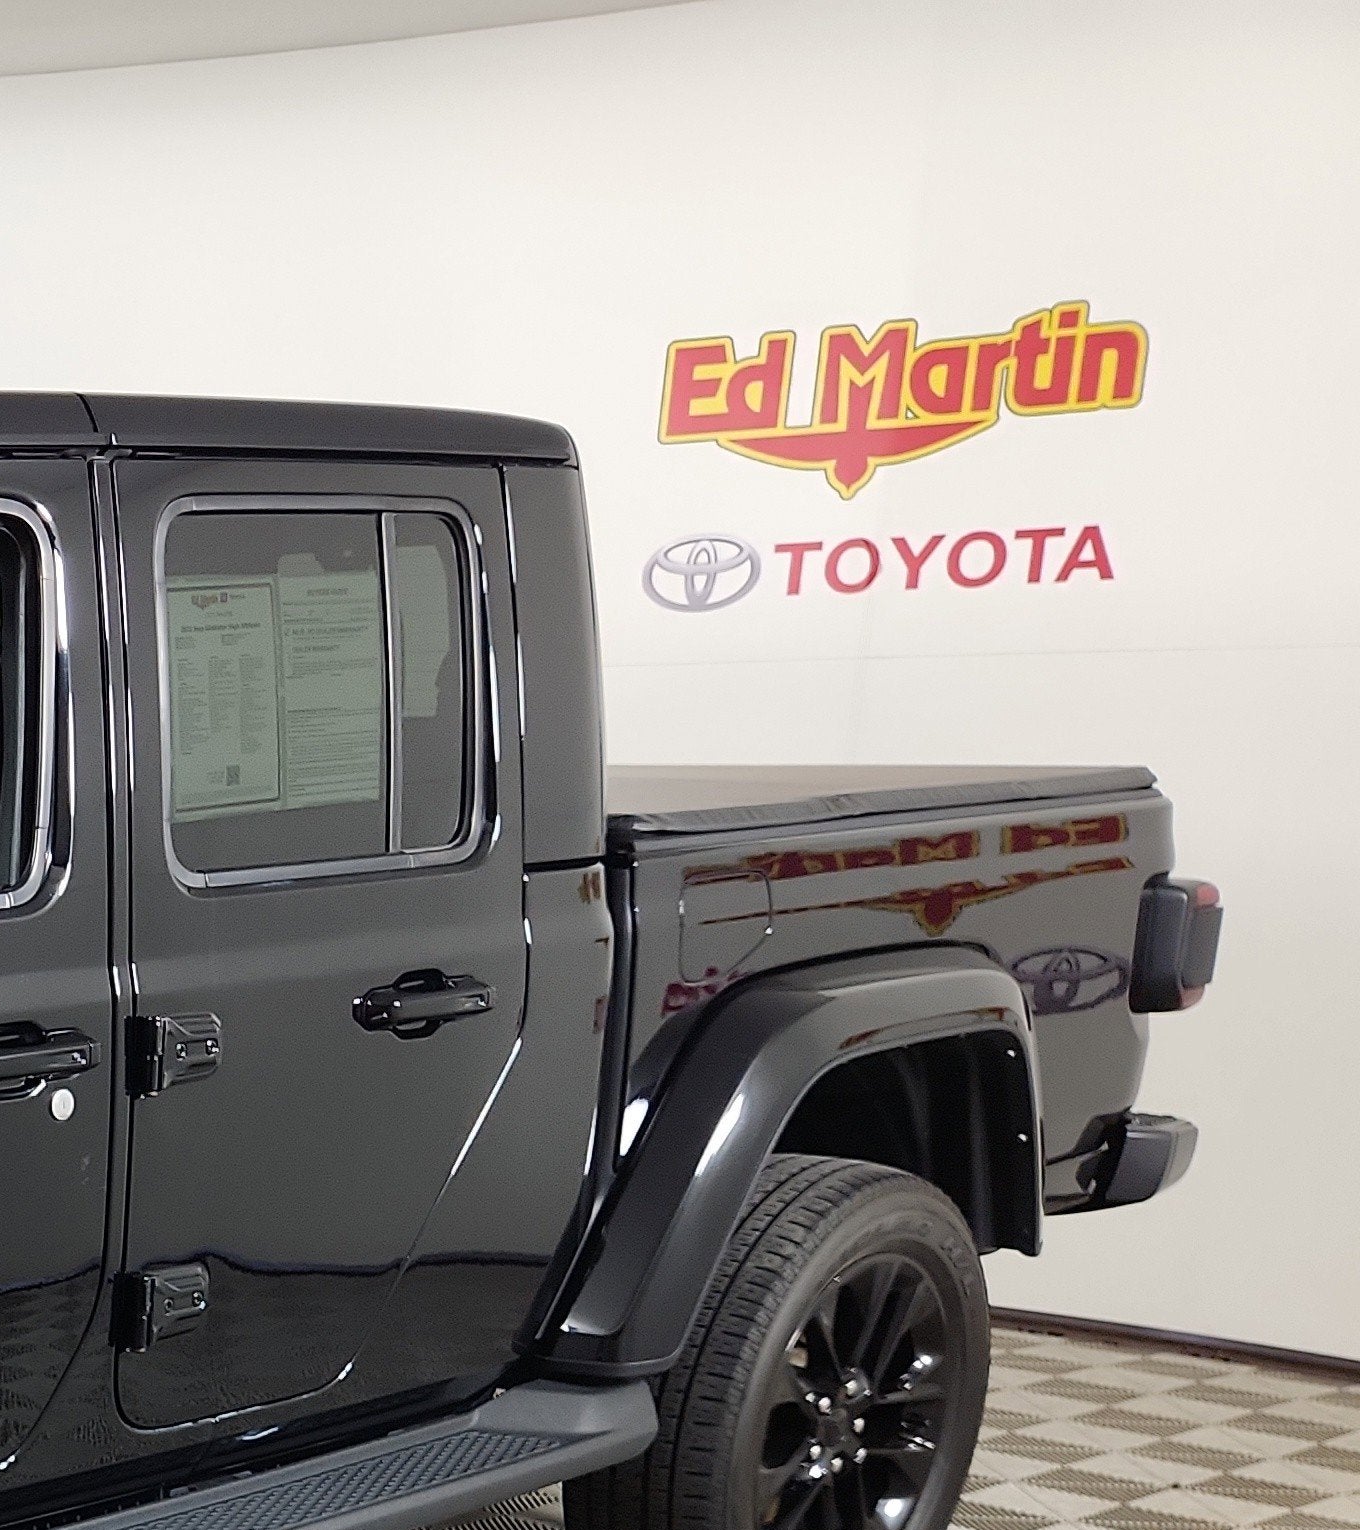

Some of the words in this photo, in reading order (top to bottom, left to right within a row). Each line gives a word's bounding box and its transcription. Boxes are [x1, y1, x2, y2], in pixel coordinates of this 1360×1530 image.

[659, 330, 795, 444] Ed
[813, 300, 1149, 428] Martin
[774, 525, 1115, 597] TOYOTA
